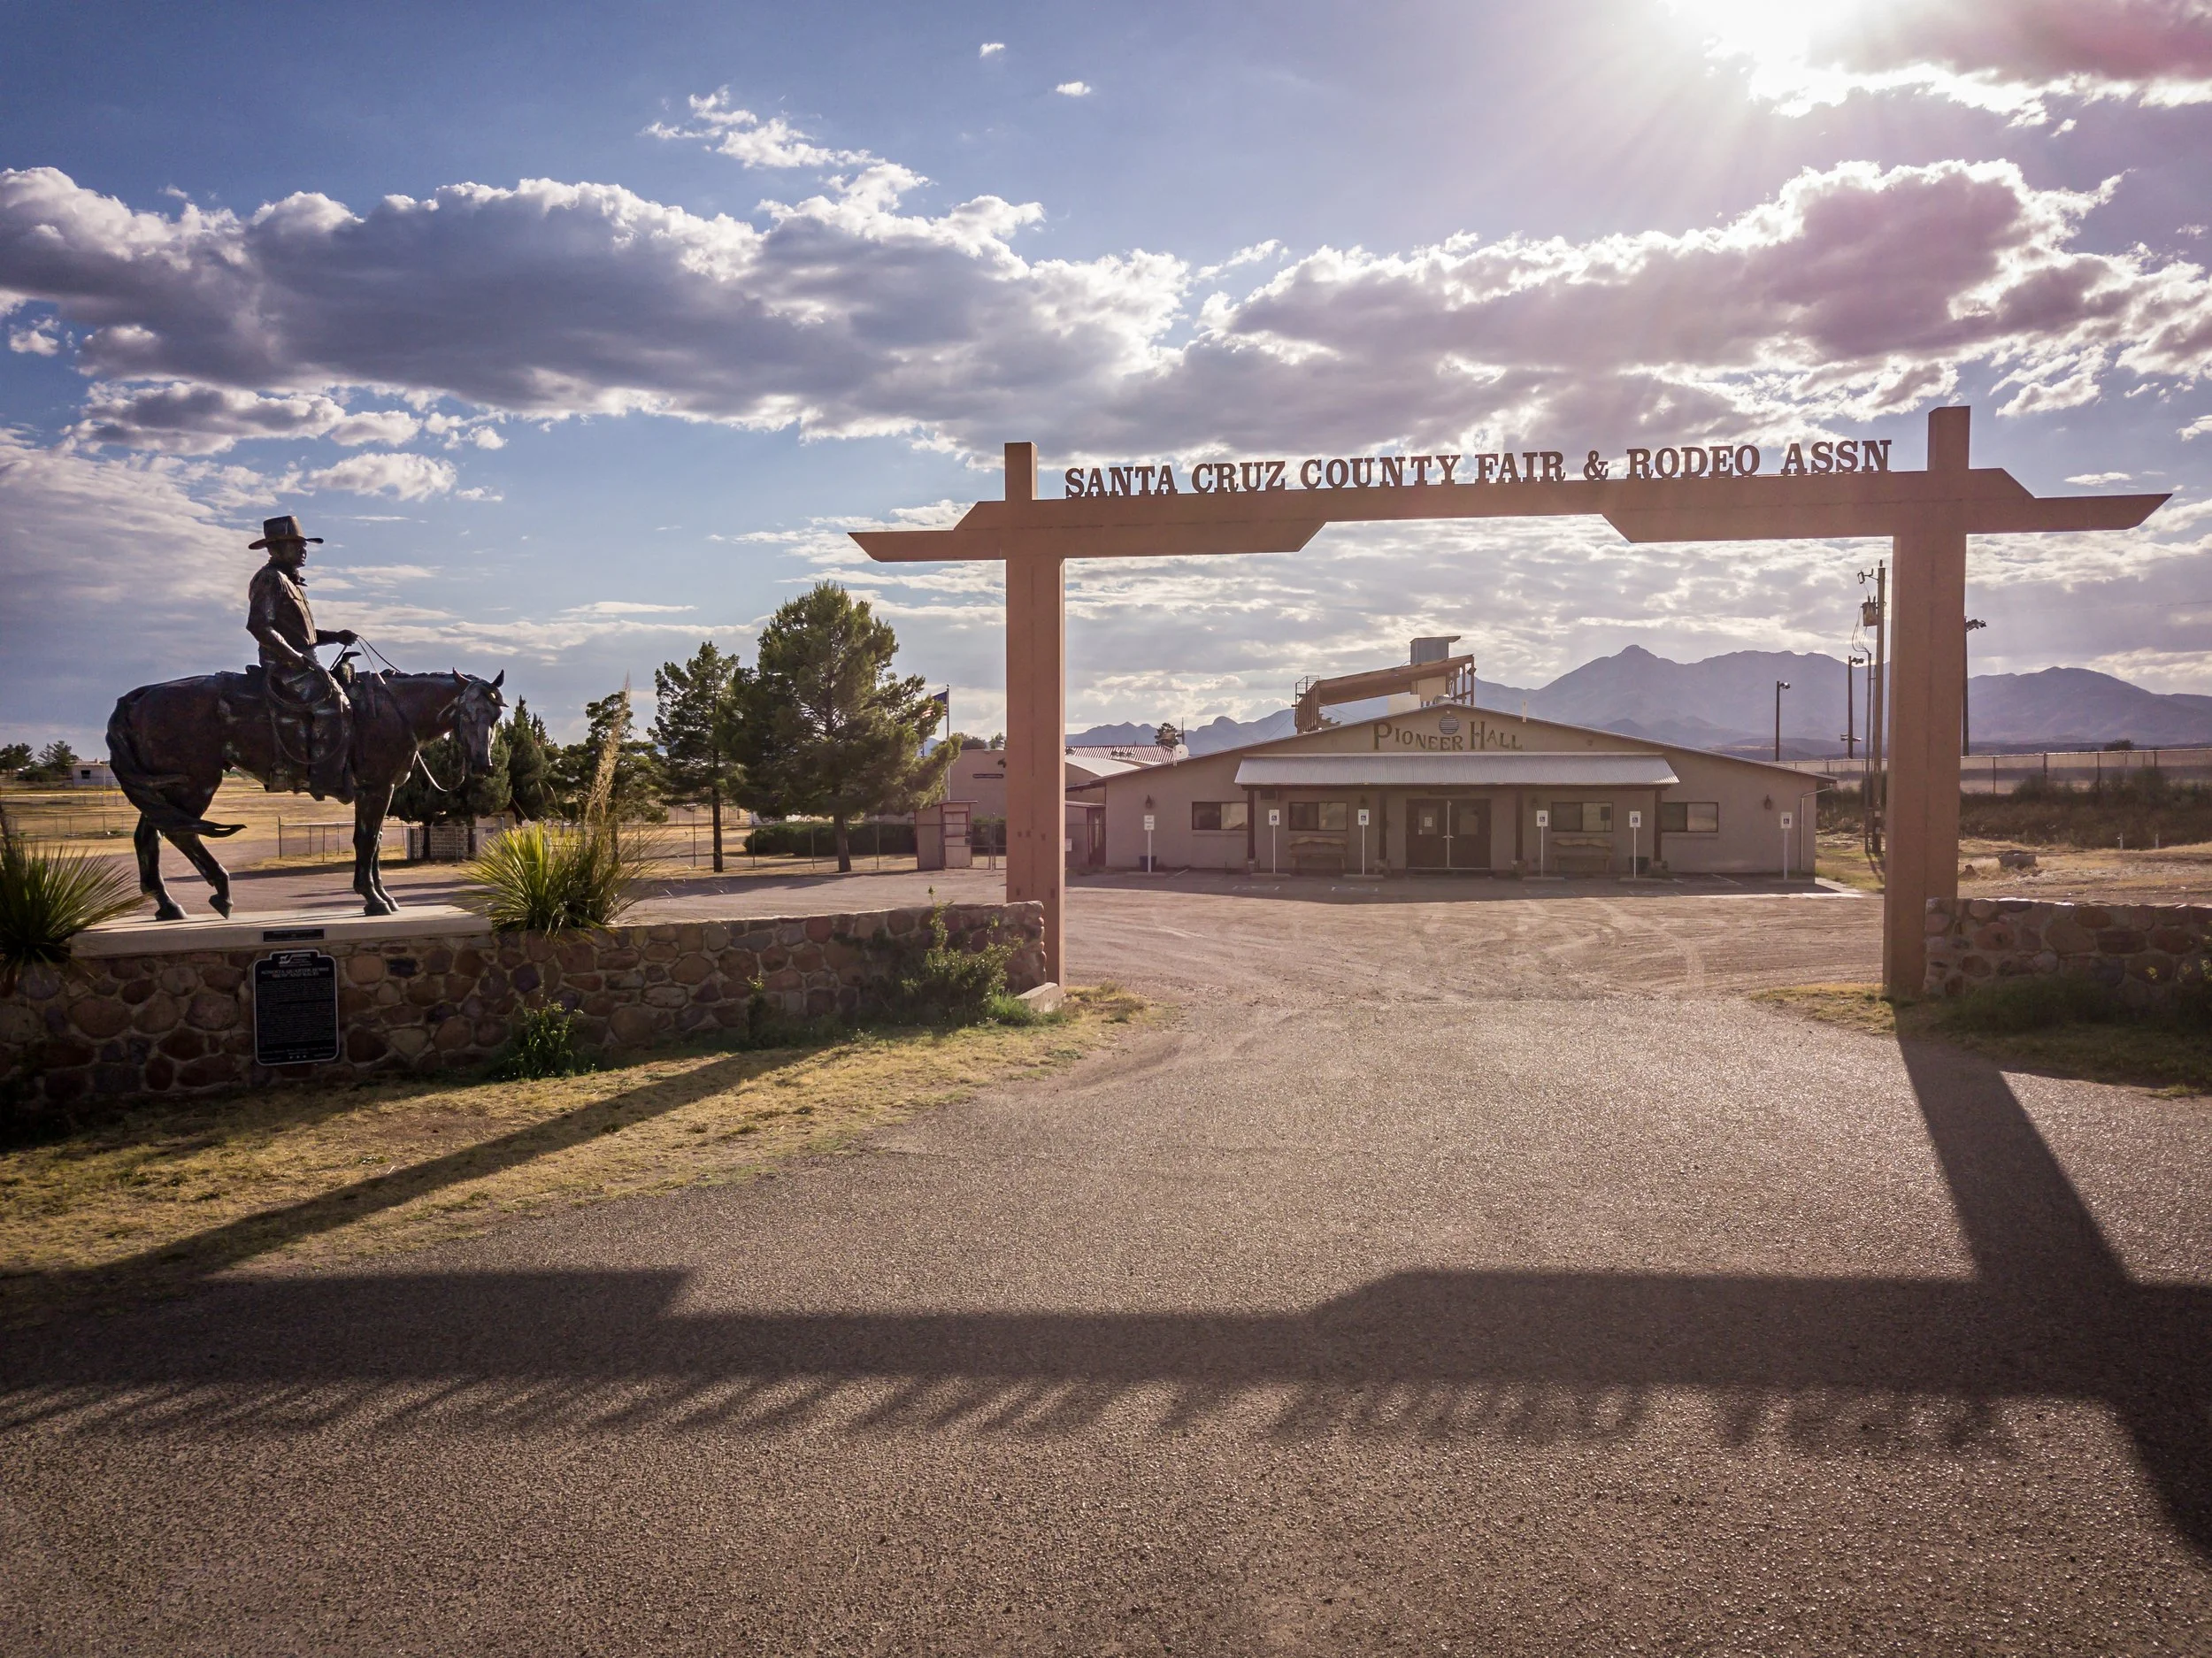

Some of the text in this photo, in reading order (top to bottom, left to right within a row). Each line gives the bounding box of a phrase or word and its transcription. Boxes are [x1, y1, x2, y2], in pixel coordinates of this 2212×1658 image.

[1065, 439, 1893, 497] SANTA CRUZ COUNTY FAIR & RODEO ASSN
